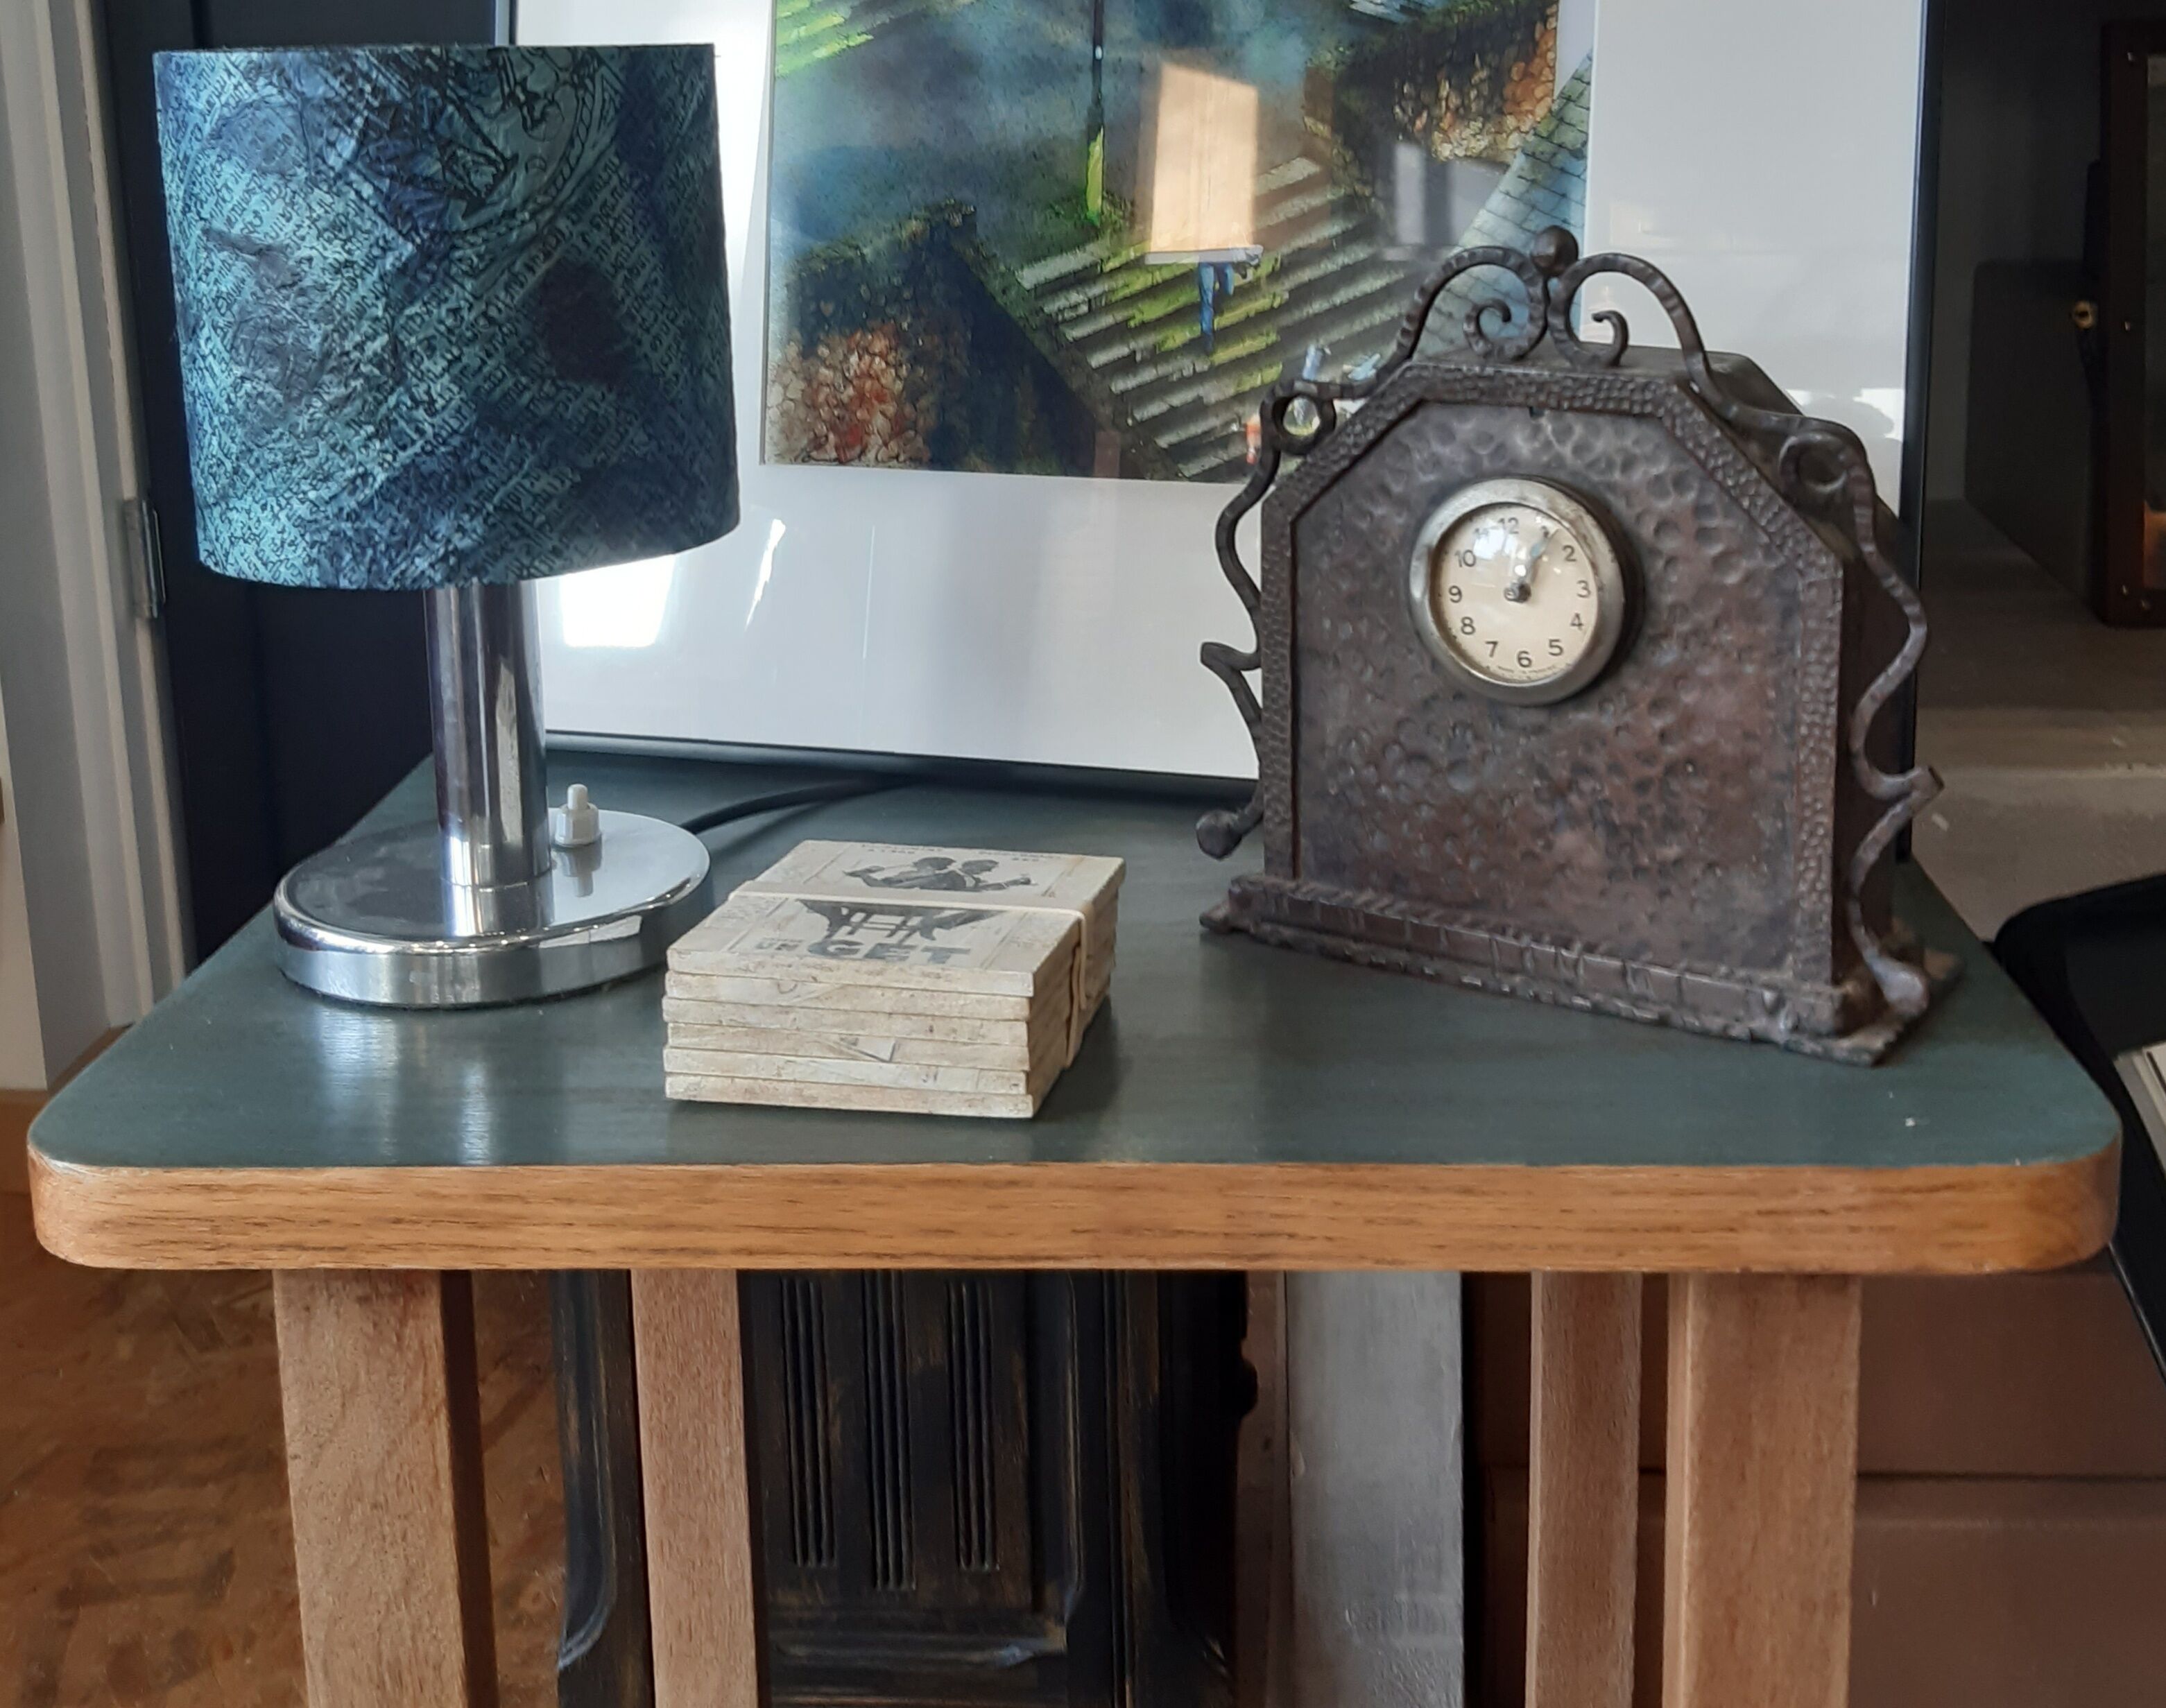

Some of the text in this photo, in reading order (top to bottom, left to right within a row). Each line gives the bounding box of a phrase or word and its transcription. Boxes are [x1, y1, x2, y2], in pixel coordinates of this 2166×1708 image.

[1497, 517, 1519, 535] 12
[1455, 549, 1477, 568] 10
[1562, 545, 1577, 562] 2
[1449, 585, 1463, 603] 9
[1576, 580, 1591, 598] 3
[1460, 616, 1476, 635] 8
[1570, 613, 1585, 631] 4
[1485, 640, 1499, 658] 7
[1548, 639, 1565, 657] 5
[1516, 650, 1533, 668] 6
[808, 938, 972, 965] GET
